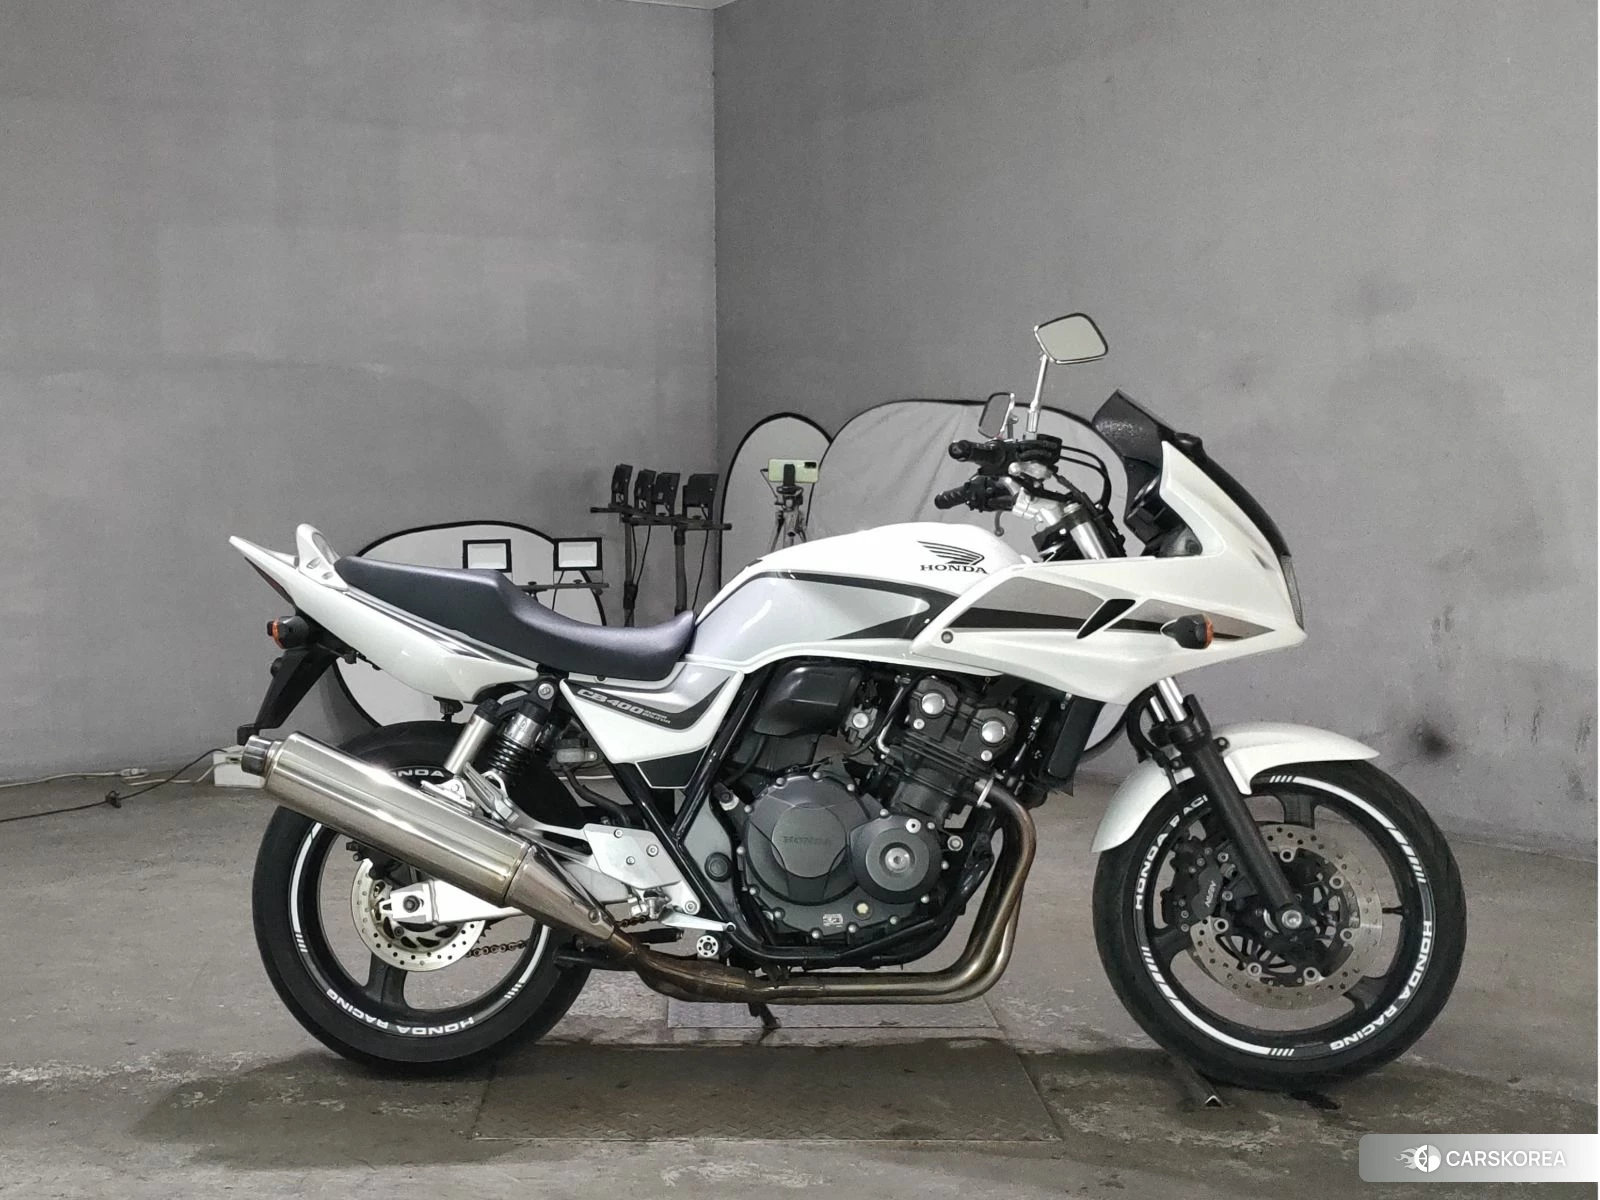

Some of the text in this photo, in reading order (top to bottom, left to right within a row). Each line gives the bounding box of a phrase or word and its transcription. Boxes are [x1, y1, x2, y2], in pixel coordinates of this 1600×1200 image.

[920, 564, 989, 575] HONDA
[577, 688, 645, 715] CB400
[391, 769, 445, 778] NDA
[1135, 833, 1169, 910] HONDA
[1329, 920, 1433, 1051] HONDA RACING
[326, 988, 475, 1036] HONDA RACING
